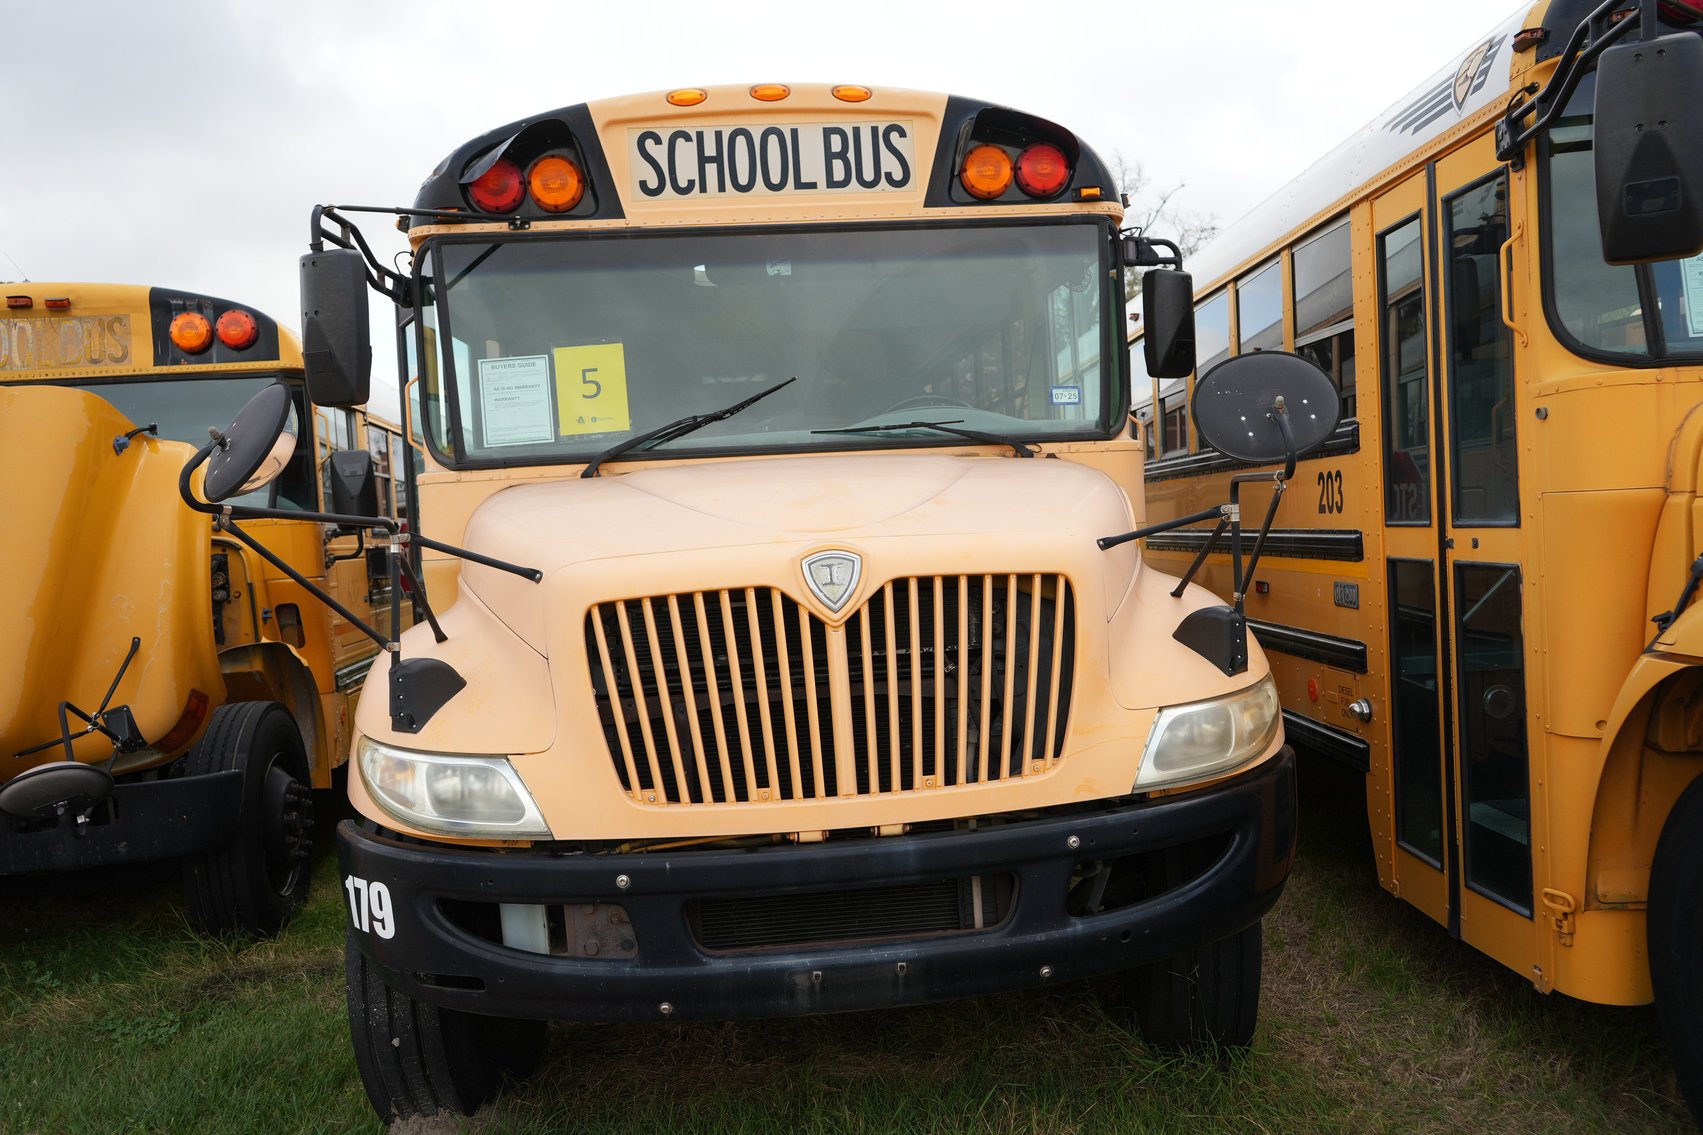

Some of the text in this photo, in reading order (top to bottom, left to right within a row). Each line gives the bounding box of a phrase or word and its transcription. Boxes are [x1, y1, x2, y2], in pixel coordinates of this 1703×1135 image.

[636, 123, 911, 197] SCHOOL BUS
[581, 367, 602, 399] 5
[1317, 469, 1344, 514] 203
[1338, 685, 1353, 697] DIESEL
[345, 874, 396, 940] 179
